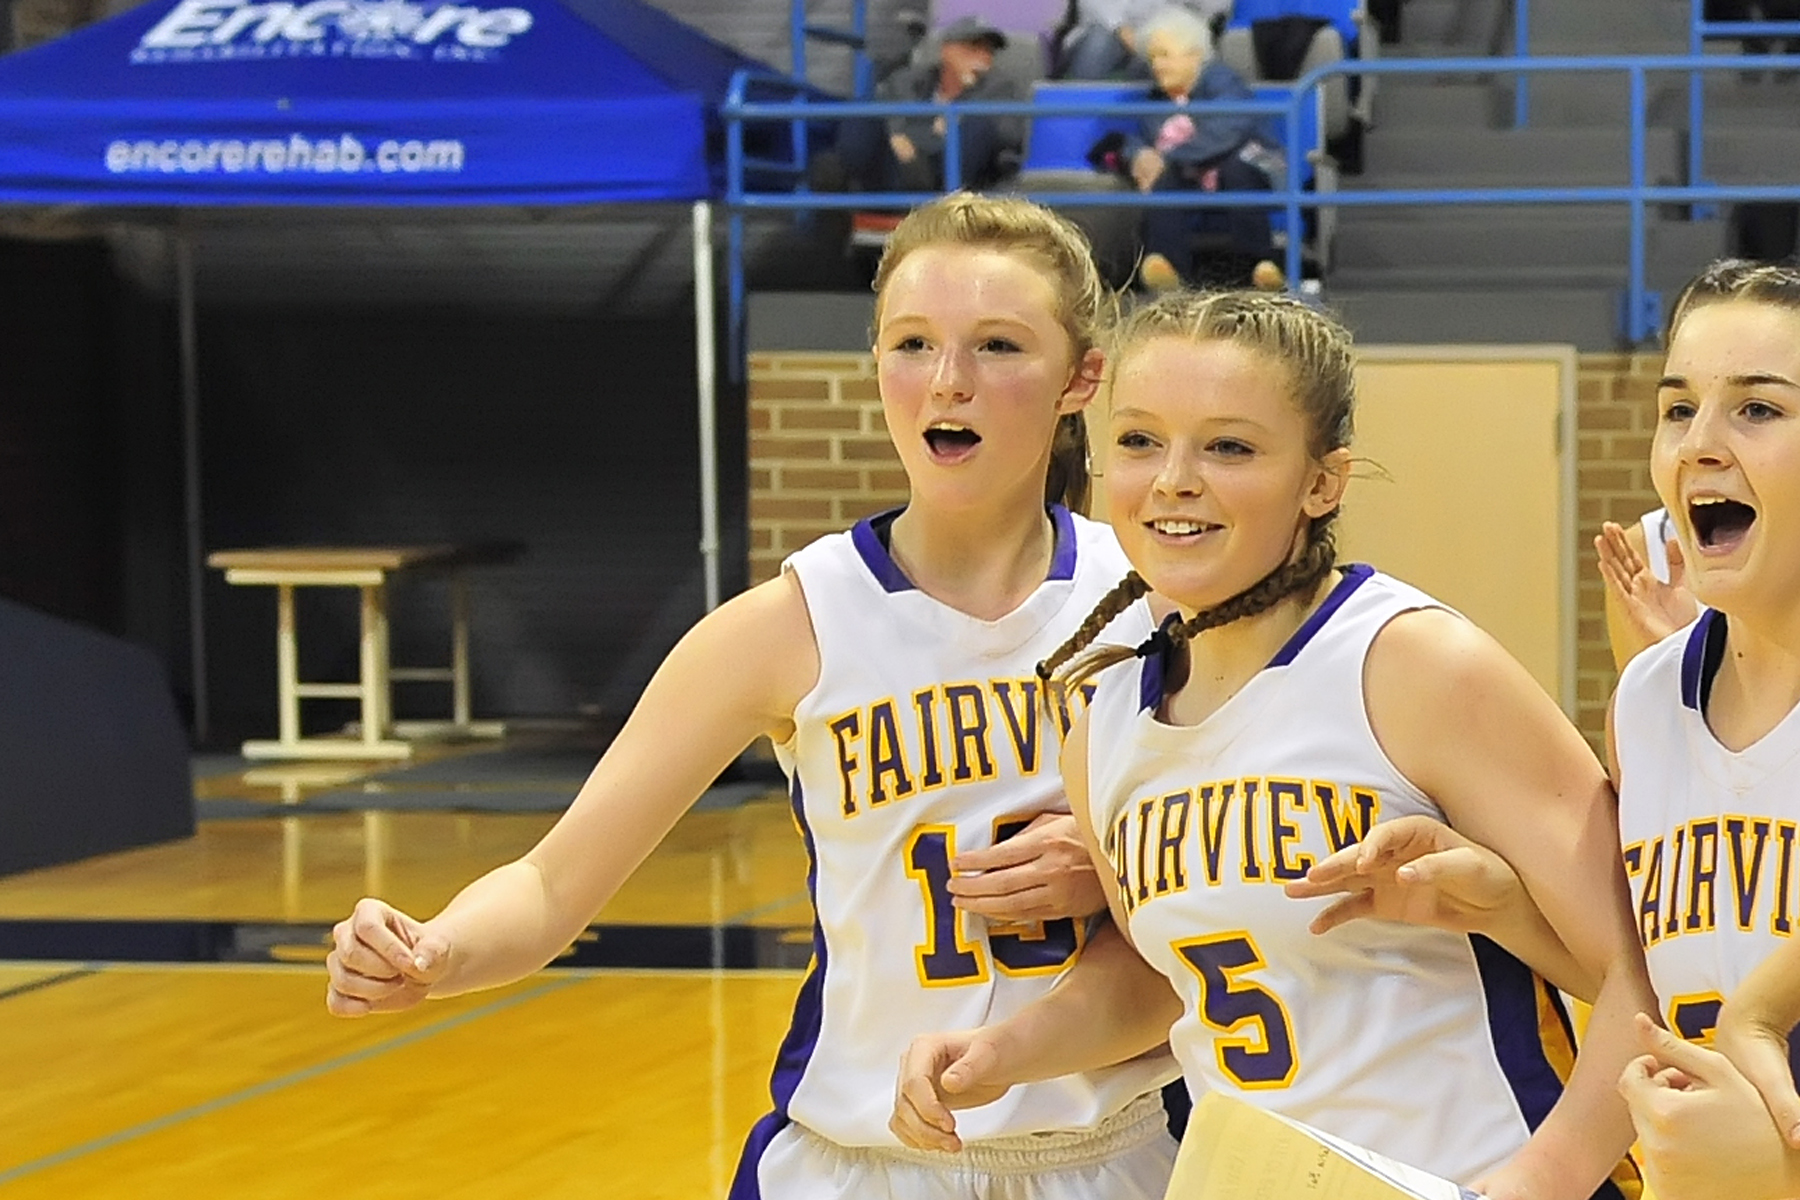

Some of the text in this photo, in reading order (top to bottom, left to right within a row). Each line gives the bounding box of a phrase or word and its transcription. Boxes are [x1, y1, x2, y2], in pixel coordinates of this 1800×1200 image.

[104, 133, 466, 174] encorerehab.com
[825, 675, 1099, 820] FAIRV
[1170, 929, 1301, 1091] 5
